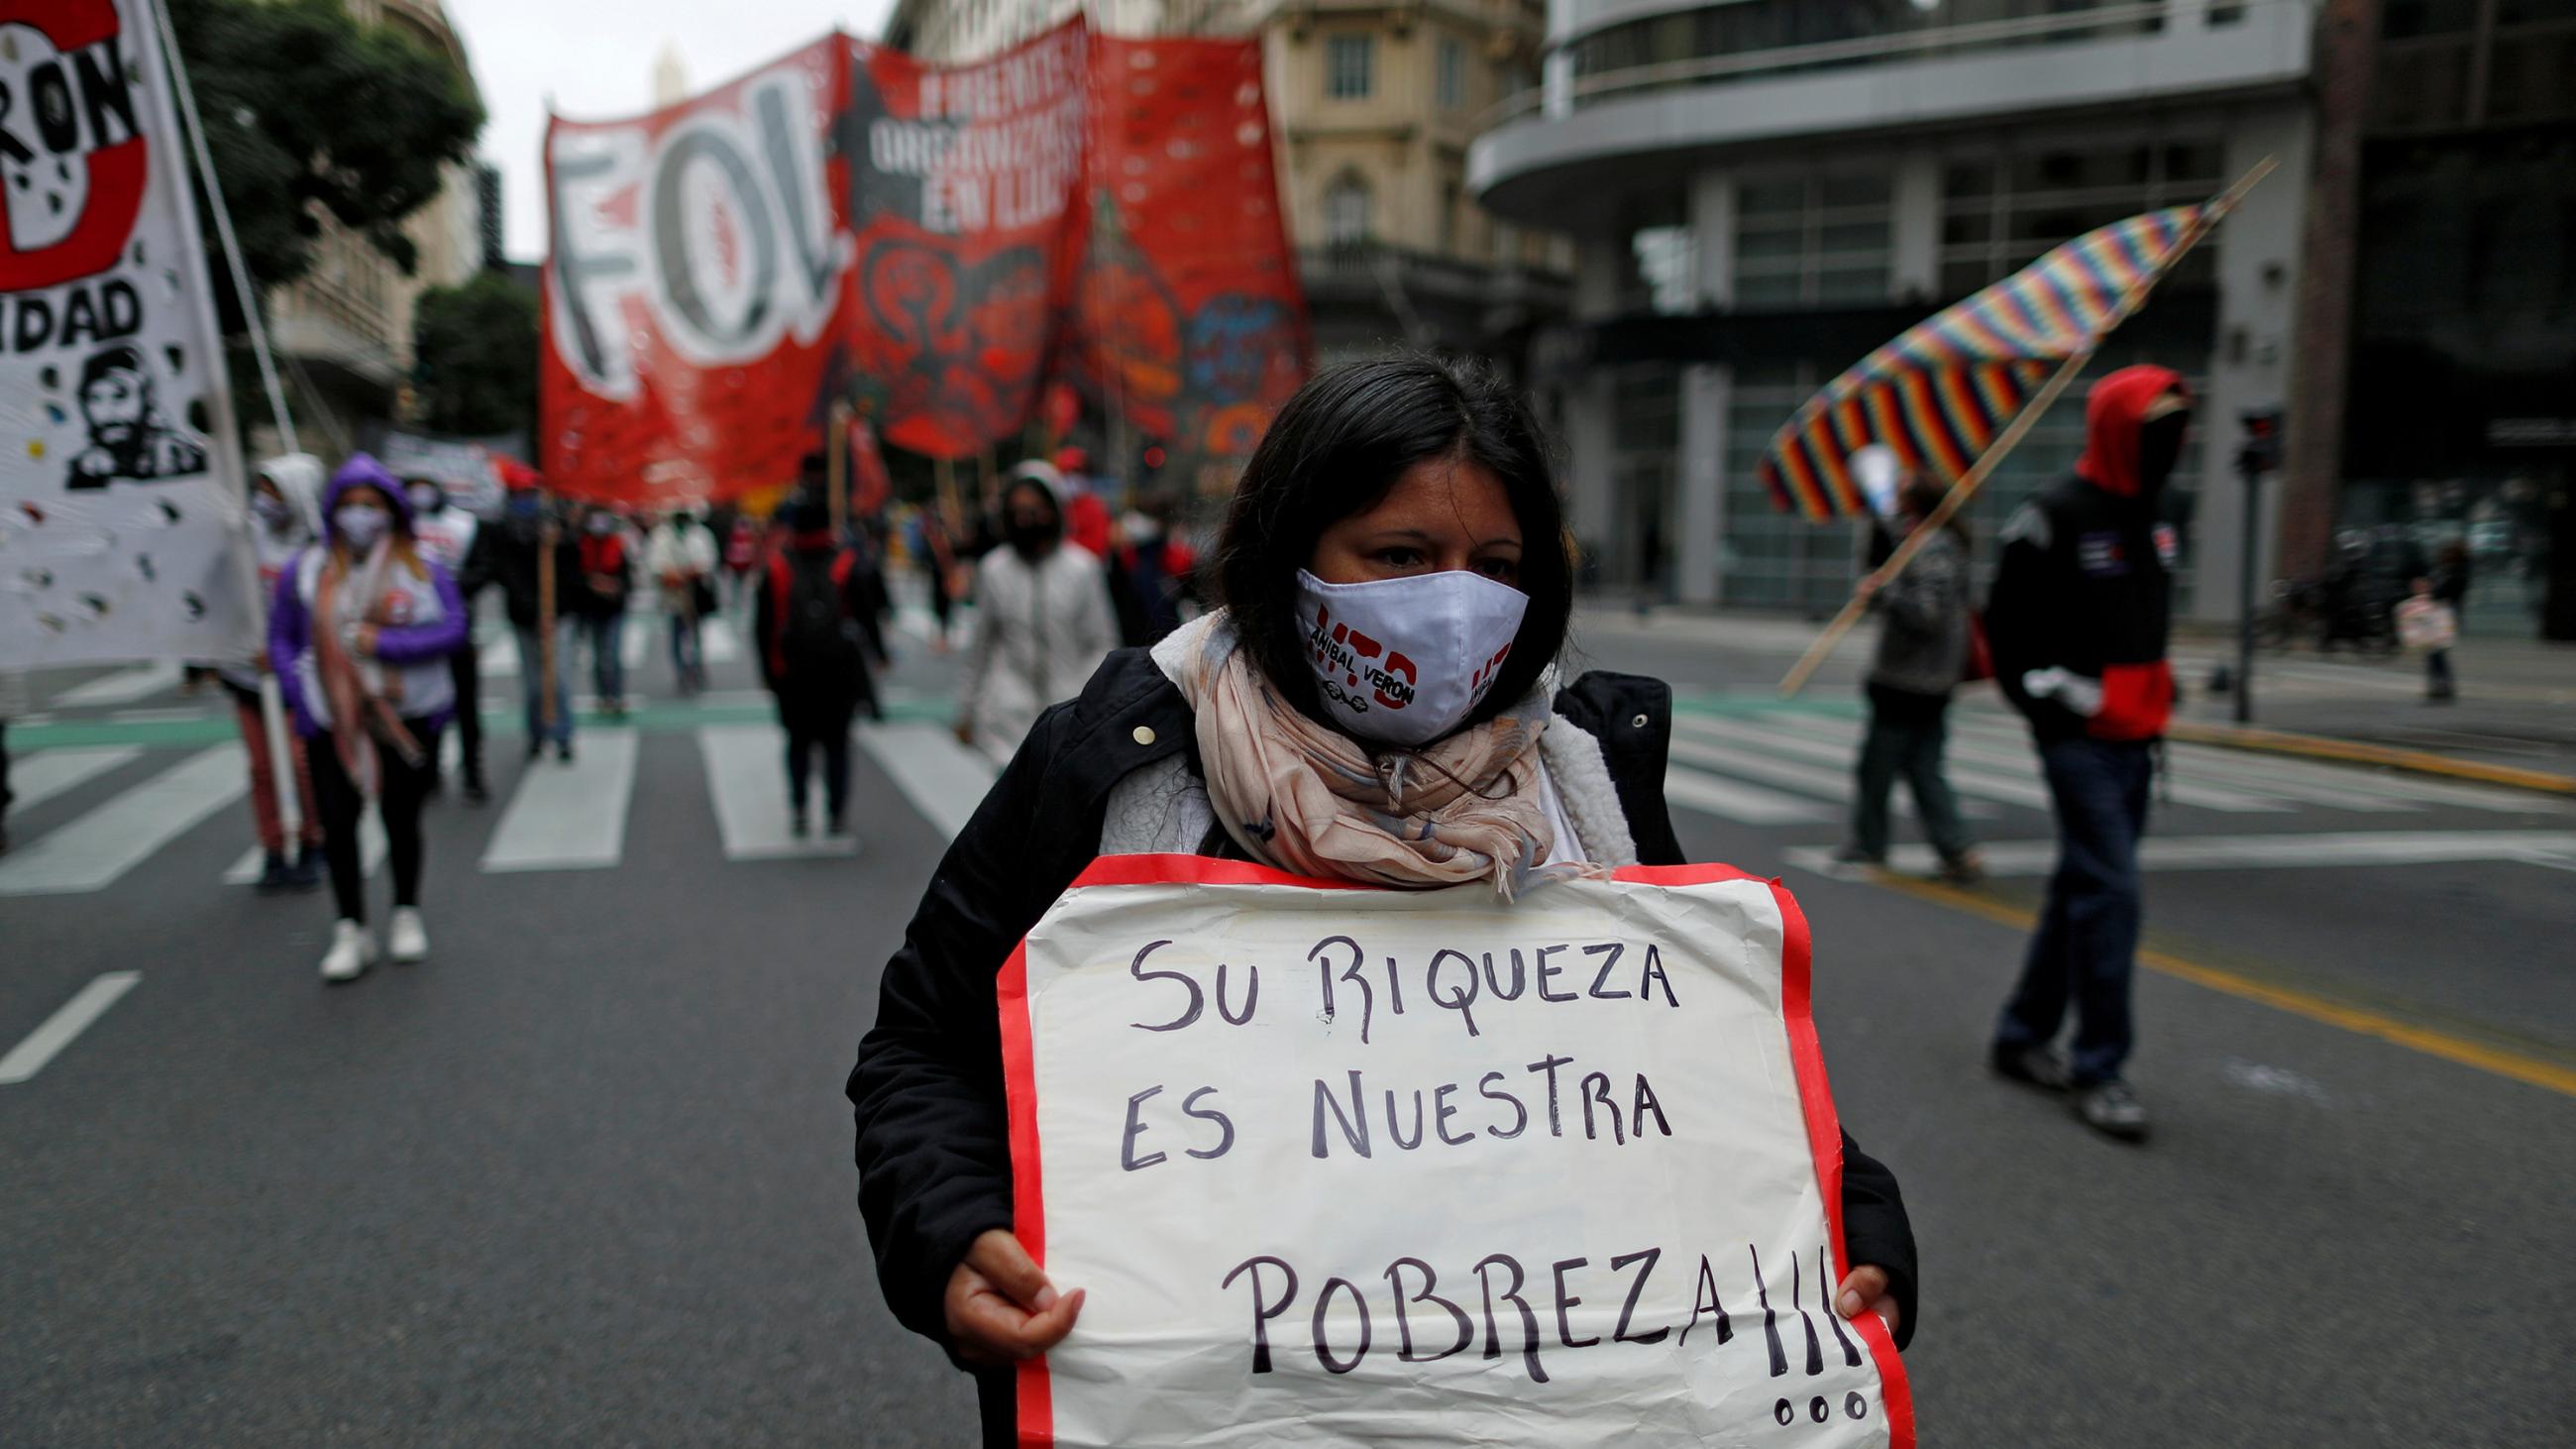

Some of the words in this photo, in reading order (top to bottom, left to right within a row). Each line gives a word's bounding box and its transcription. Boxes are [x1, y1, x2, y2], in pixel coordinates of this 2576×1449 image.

[1310, 625, 1355, 673] ANIBAL
[1363, 664, 1416, 705] VERON
[1129, 940, 1258, 1032] SU
[1308, 935, 1679, 1044] RIQUEZA
[1121, 1084, 1235, 1172] ES
[1311, 1054, 1672, 1160] NUESTRA
